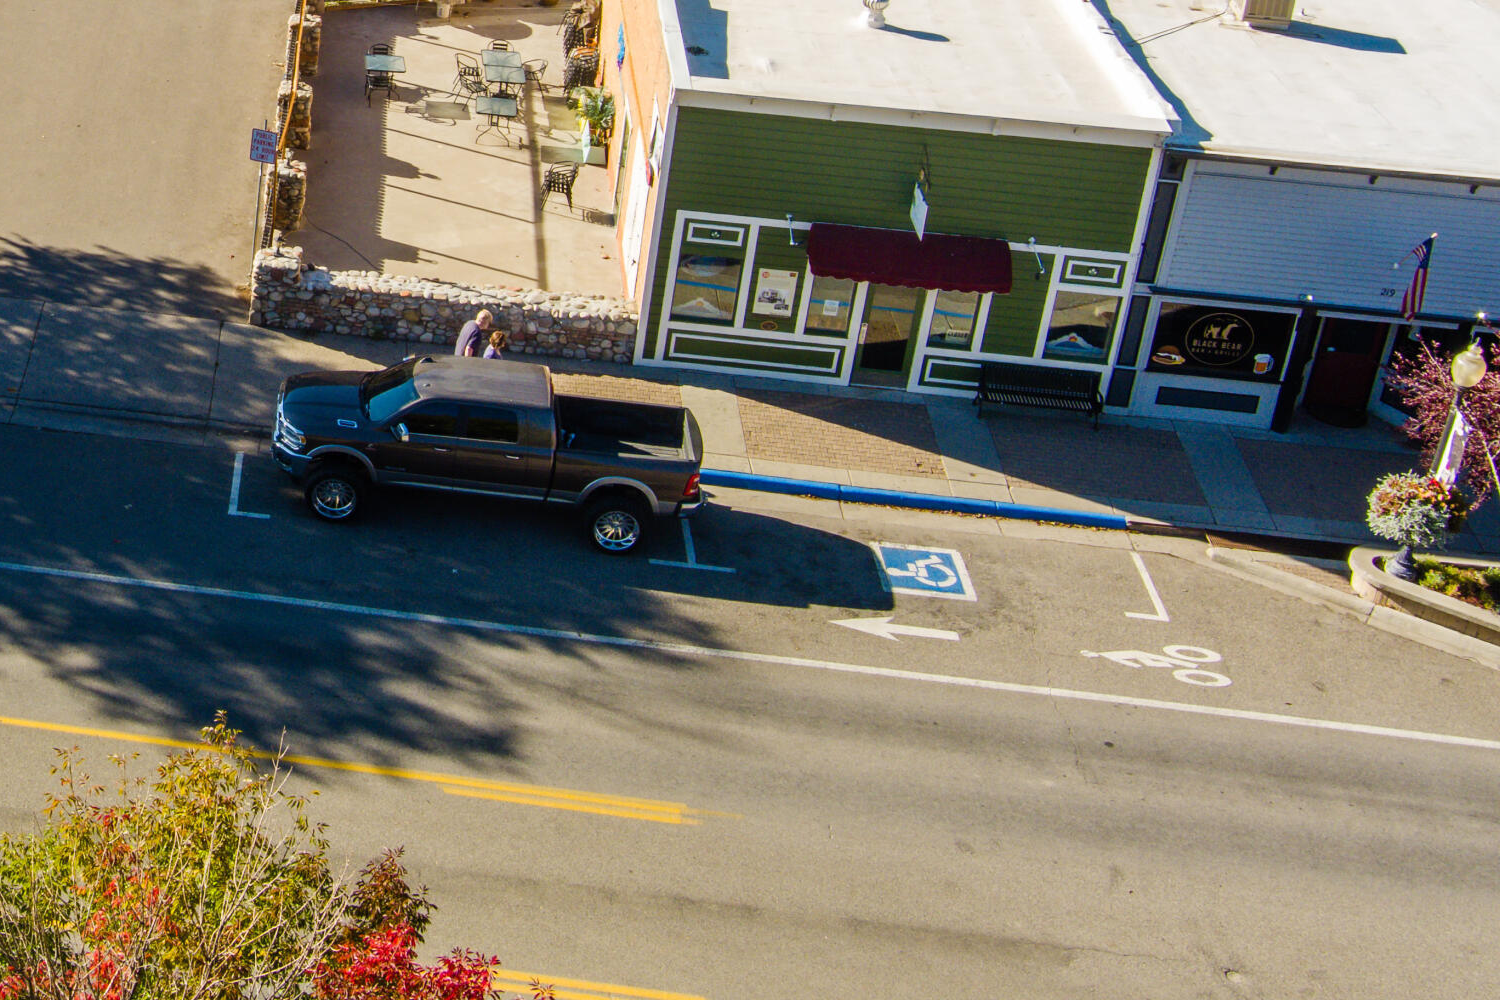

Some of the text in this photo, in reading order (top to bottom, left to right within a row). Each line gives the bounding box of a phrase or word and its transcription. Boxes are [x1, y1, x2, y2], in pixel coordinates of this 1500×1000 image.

[1380, 287, 1396, 297] 219
[1192, 339, 1242, 350] BLACK BEAR
